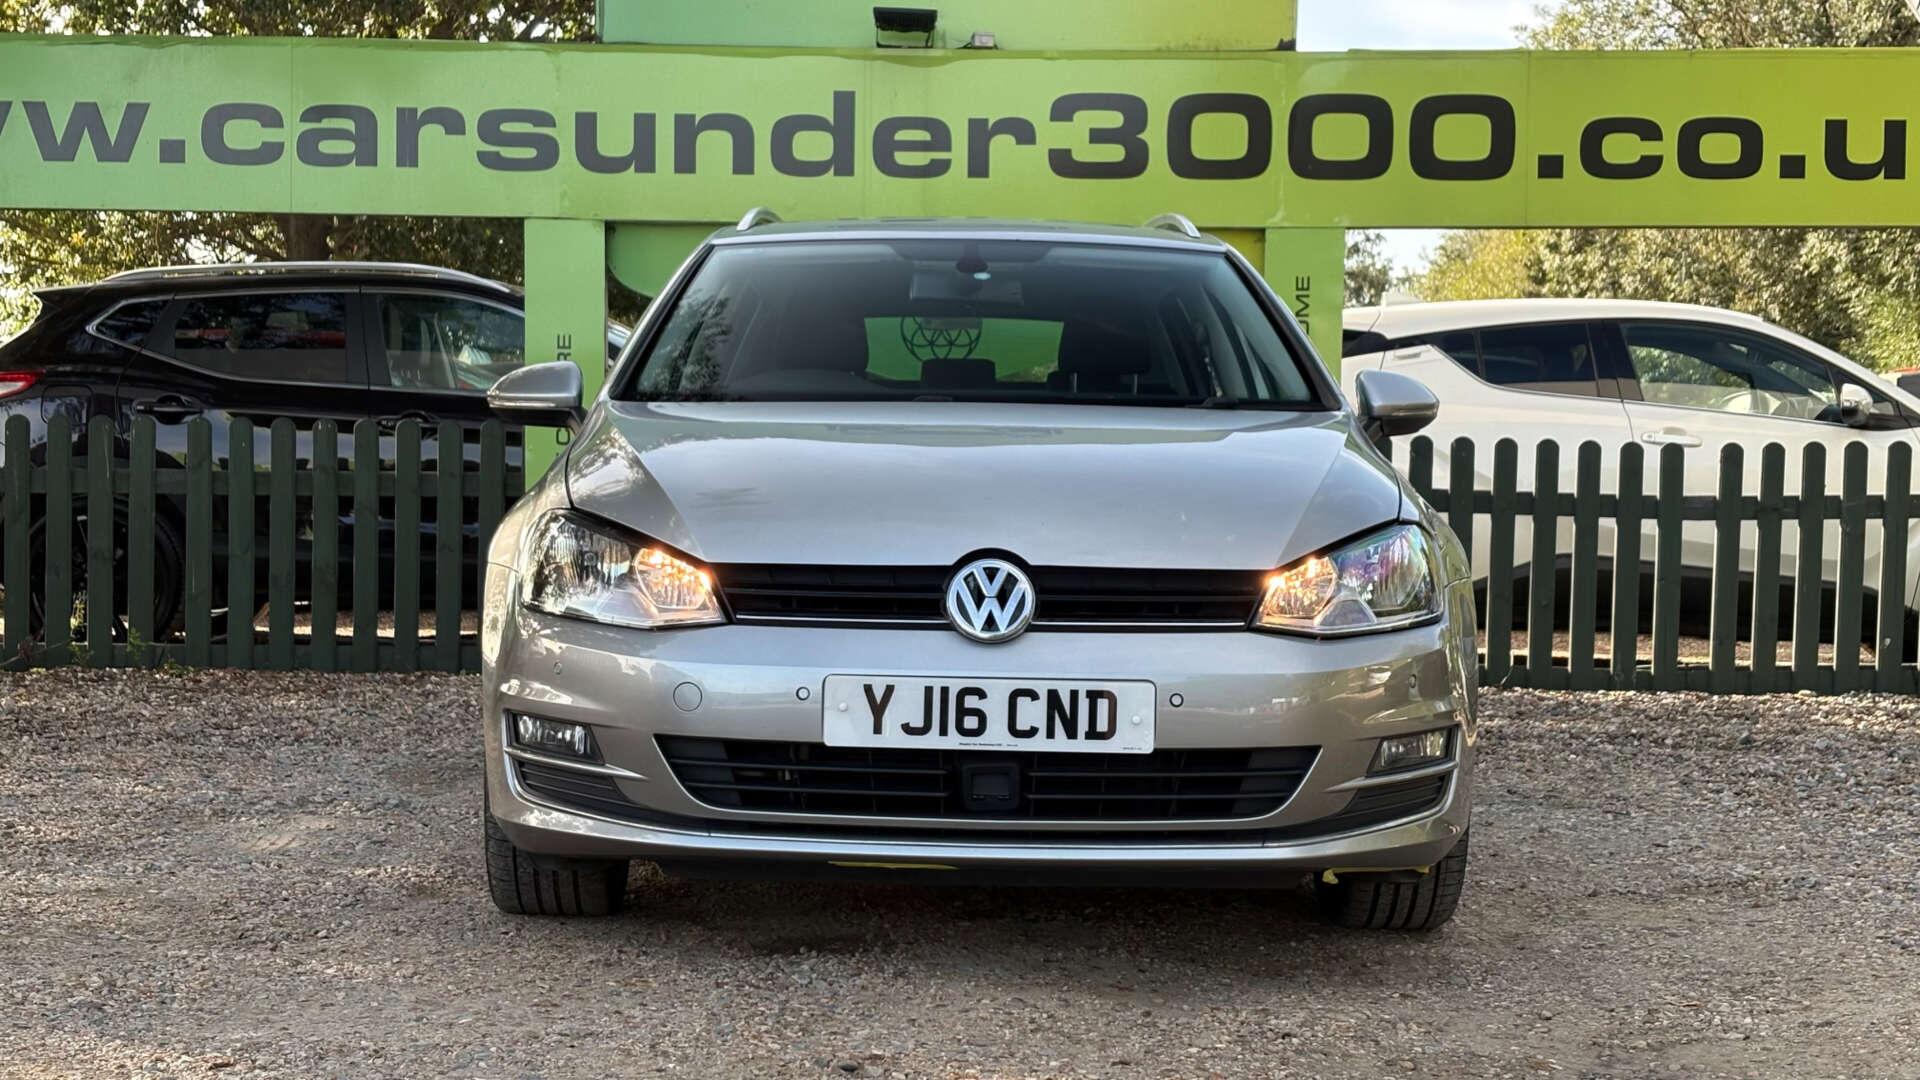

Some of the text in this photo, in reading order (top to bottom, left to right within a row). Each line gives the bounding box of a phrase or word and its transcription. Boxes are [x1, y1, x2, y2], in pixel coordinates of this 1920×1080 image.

[0, 90, 1908, 182] w.carsunder3000.co.u
[863, 683, 1119, 741] YJ16 CND
